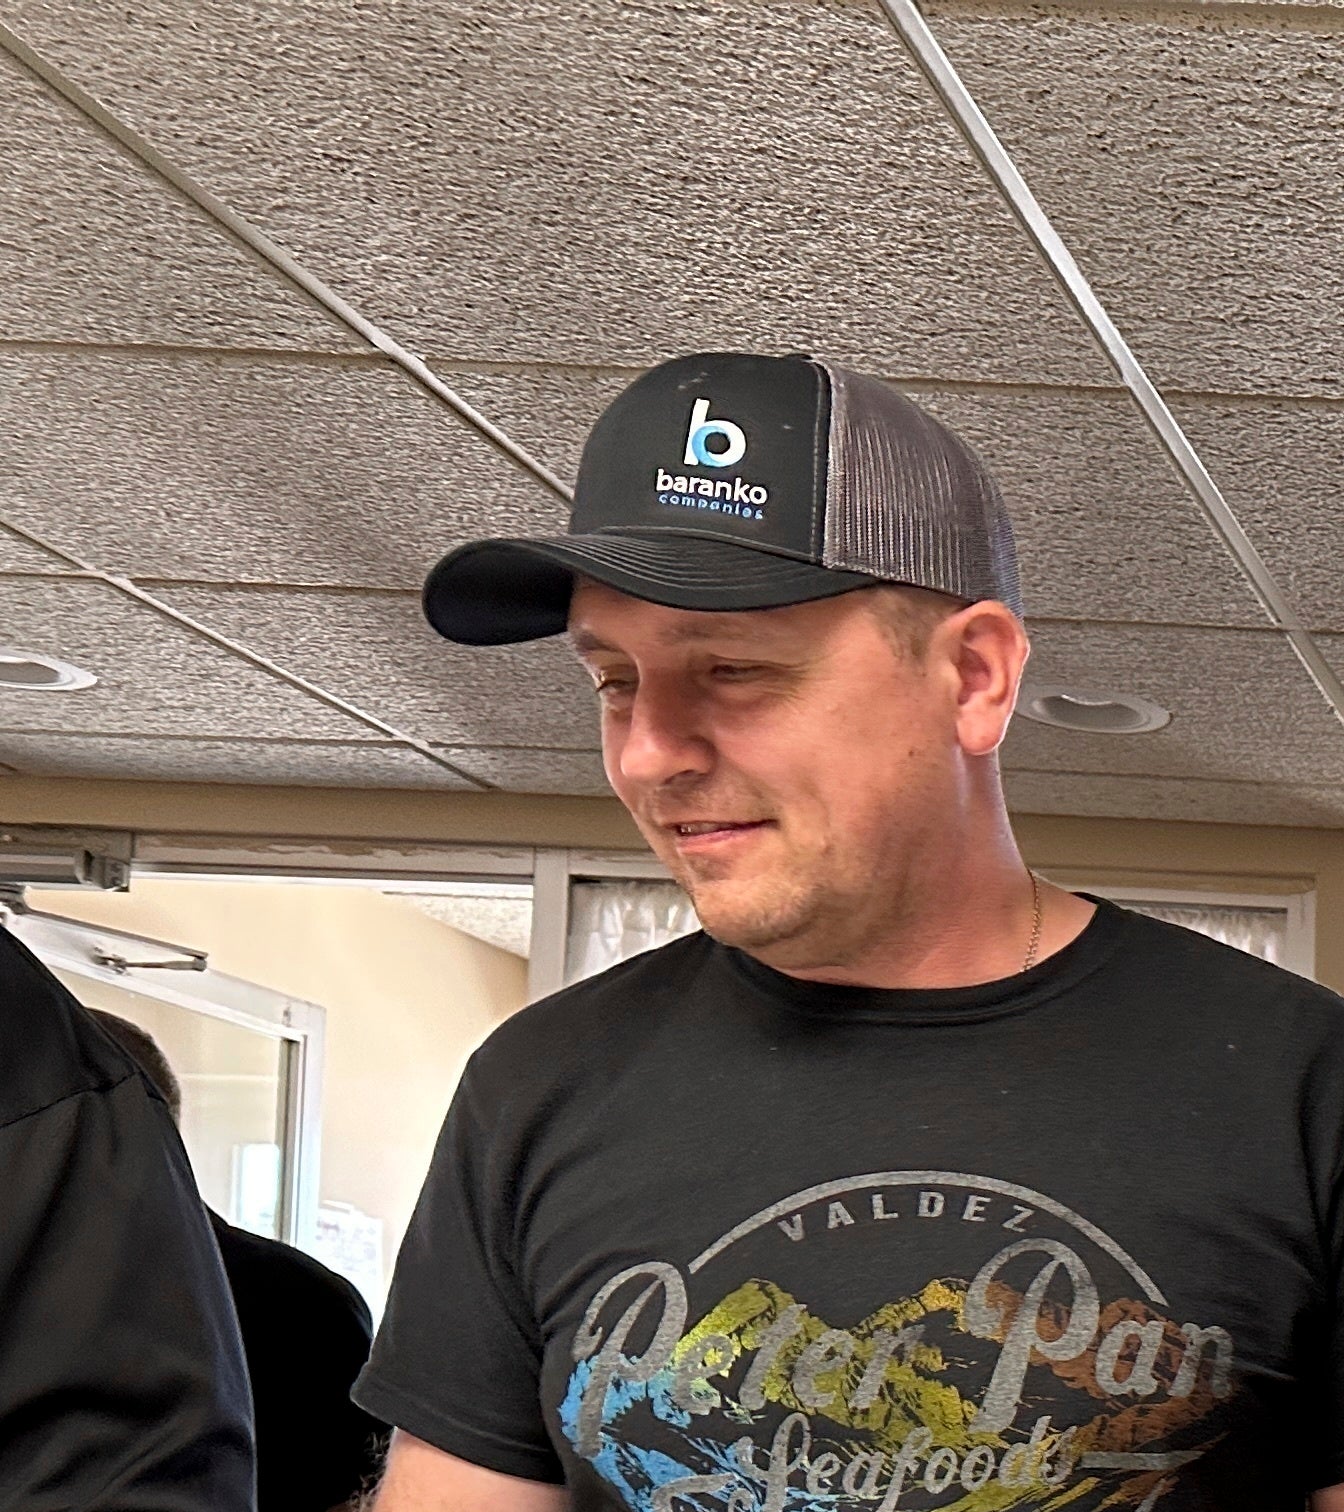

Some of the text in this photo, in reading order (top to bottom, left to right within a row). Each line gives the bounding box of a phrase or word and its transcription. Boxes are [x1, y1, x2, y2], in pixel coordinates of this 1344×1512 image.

[656, 468, 768, 505] baranko
[659, 494, 764, 520] companies
[777, 1190, 1039, 1243] VALDEZ
[573, 1237, 1233, 1458] Peter Pan
